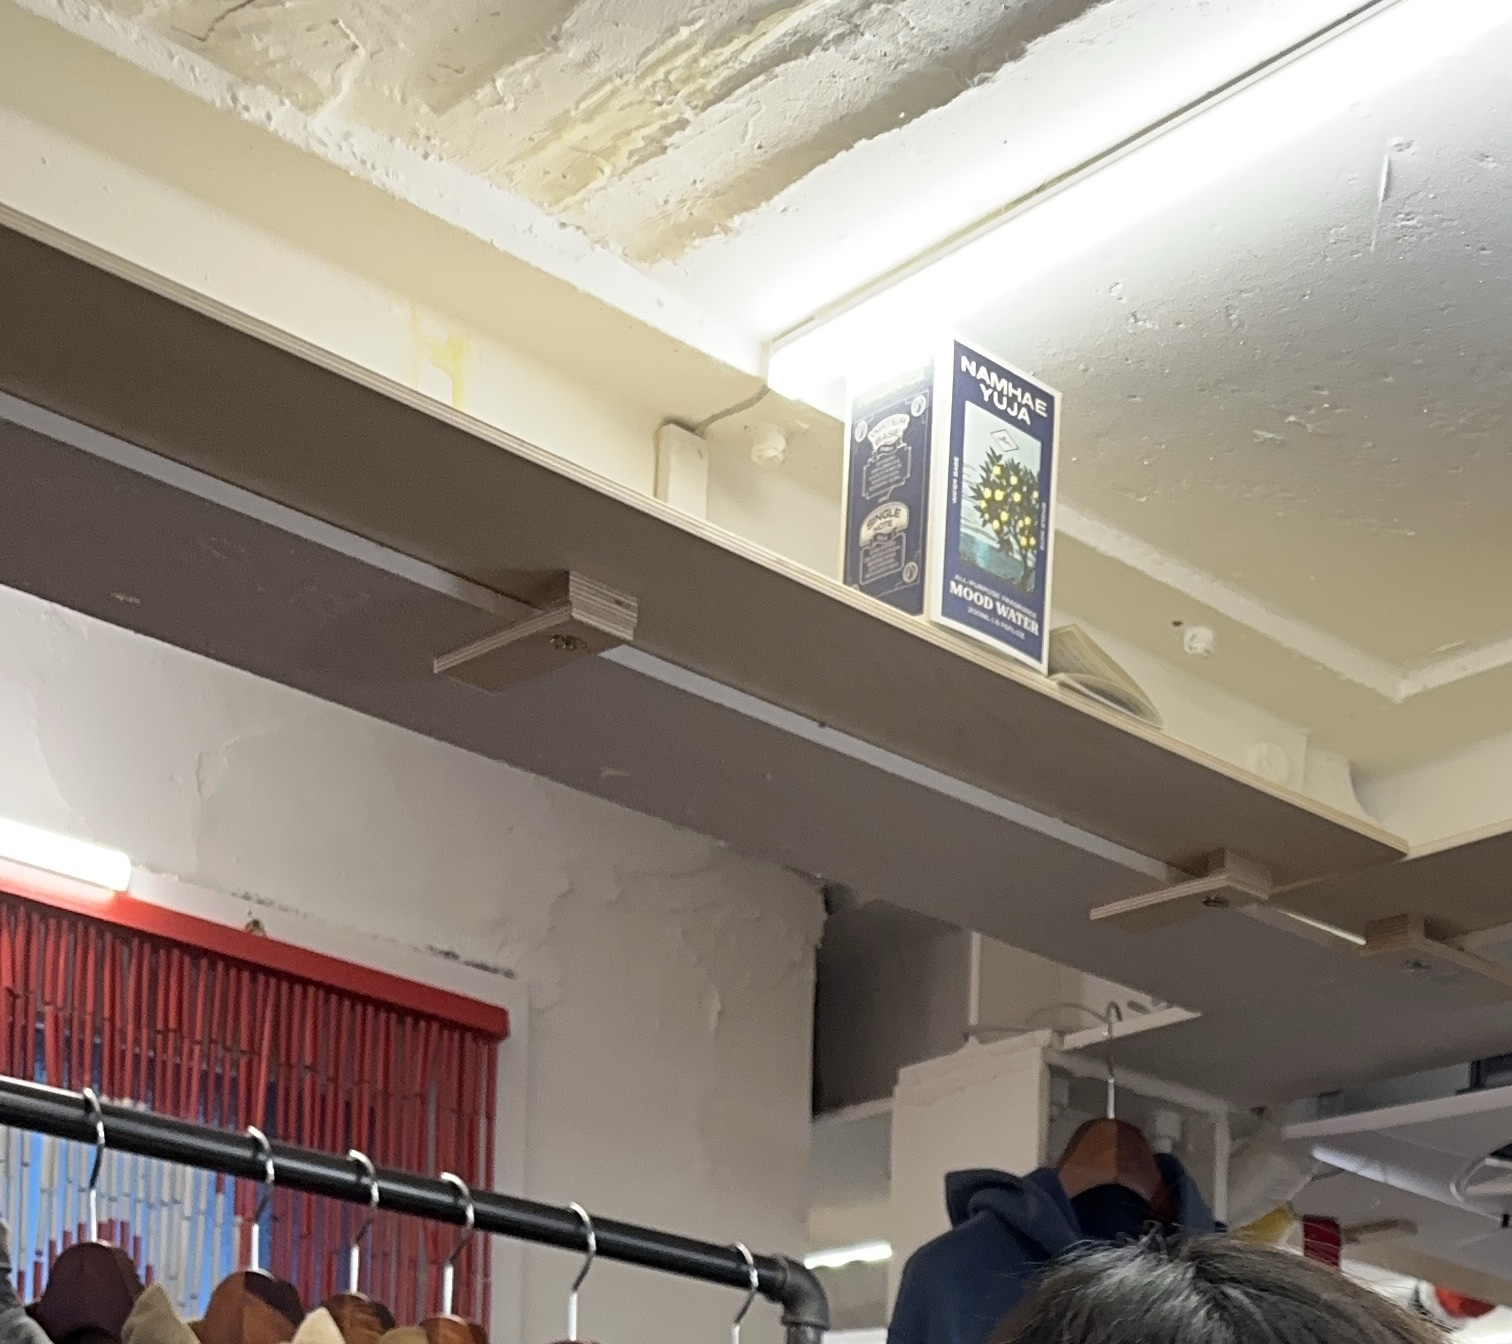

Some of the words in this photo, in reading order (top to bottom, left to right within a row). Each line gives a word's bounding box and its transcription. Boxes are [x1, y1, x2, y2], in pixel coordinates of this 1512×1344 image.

[960, 355, 1047, 418] NAMHAE
[979, 383, 1031, 426] YUJA
[949, 579, 994, 611] MOOD
[995, 600, 1040, 637] WATER
